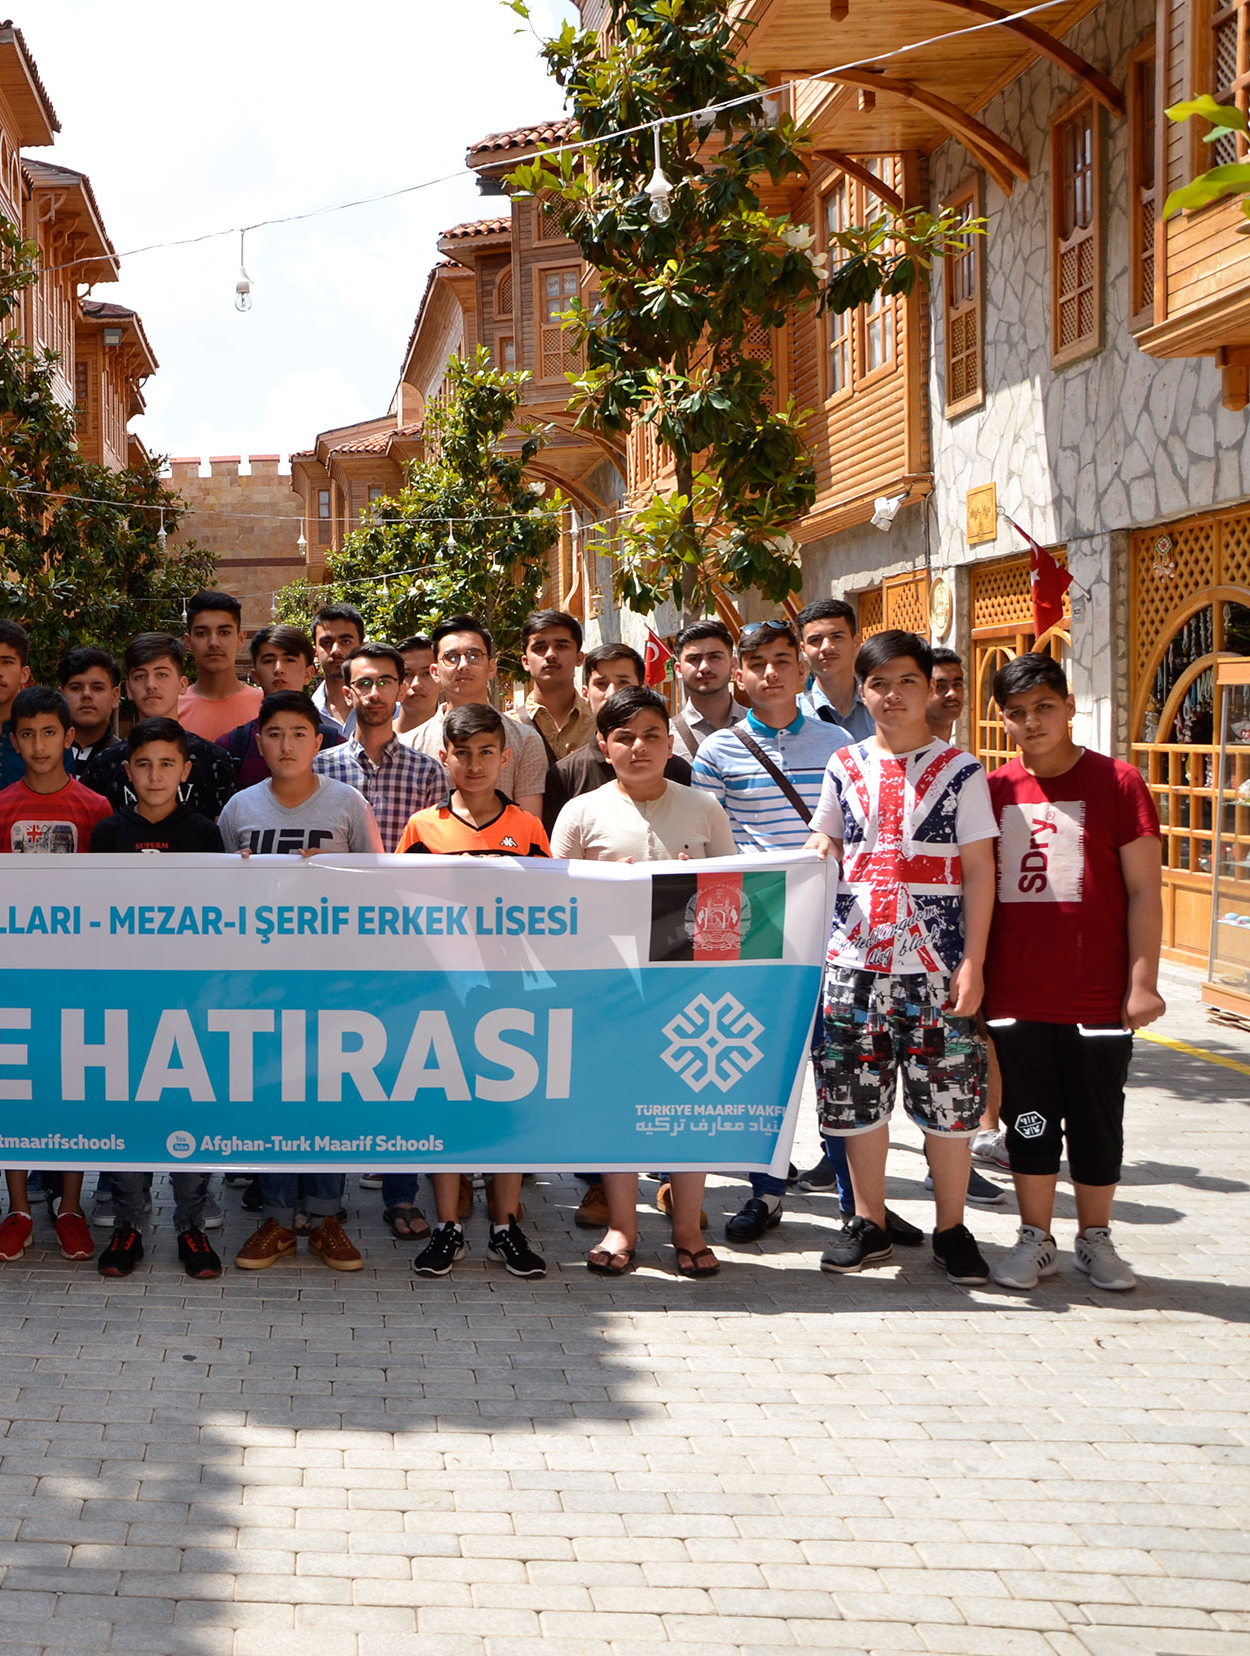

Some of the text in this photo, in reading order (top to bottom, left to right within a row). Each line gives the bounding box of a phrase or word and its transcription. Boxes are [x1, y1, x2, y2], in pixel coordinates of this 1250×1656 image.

[1018, 818, 1057, 893] SDry
[110, 905, 247, 936] MEZAR-I
[255, 897, 350, 945] ŞERİF
[358, 905, 468, 936] ERKEK
[476, 896, 578, 936] LİSESİ
[61, 1007, 574, 1103] HATIRASI
[200, 1135, 444, 1156] Afghan-Turk Maarif Schools
